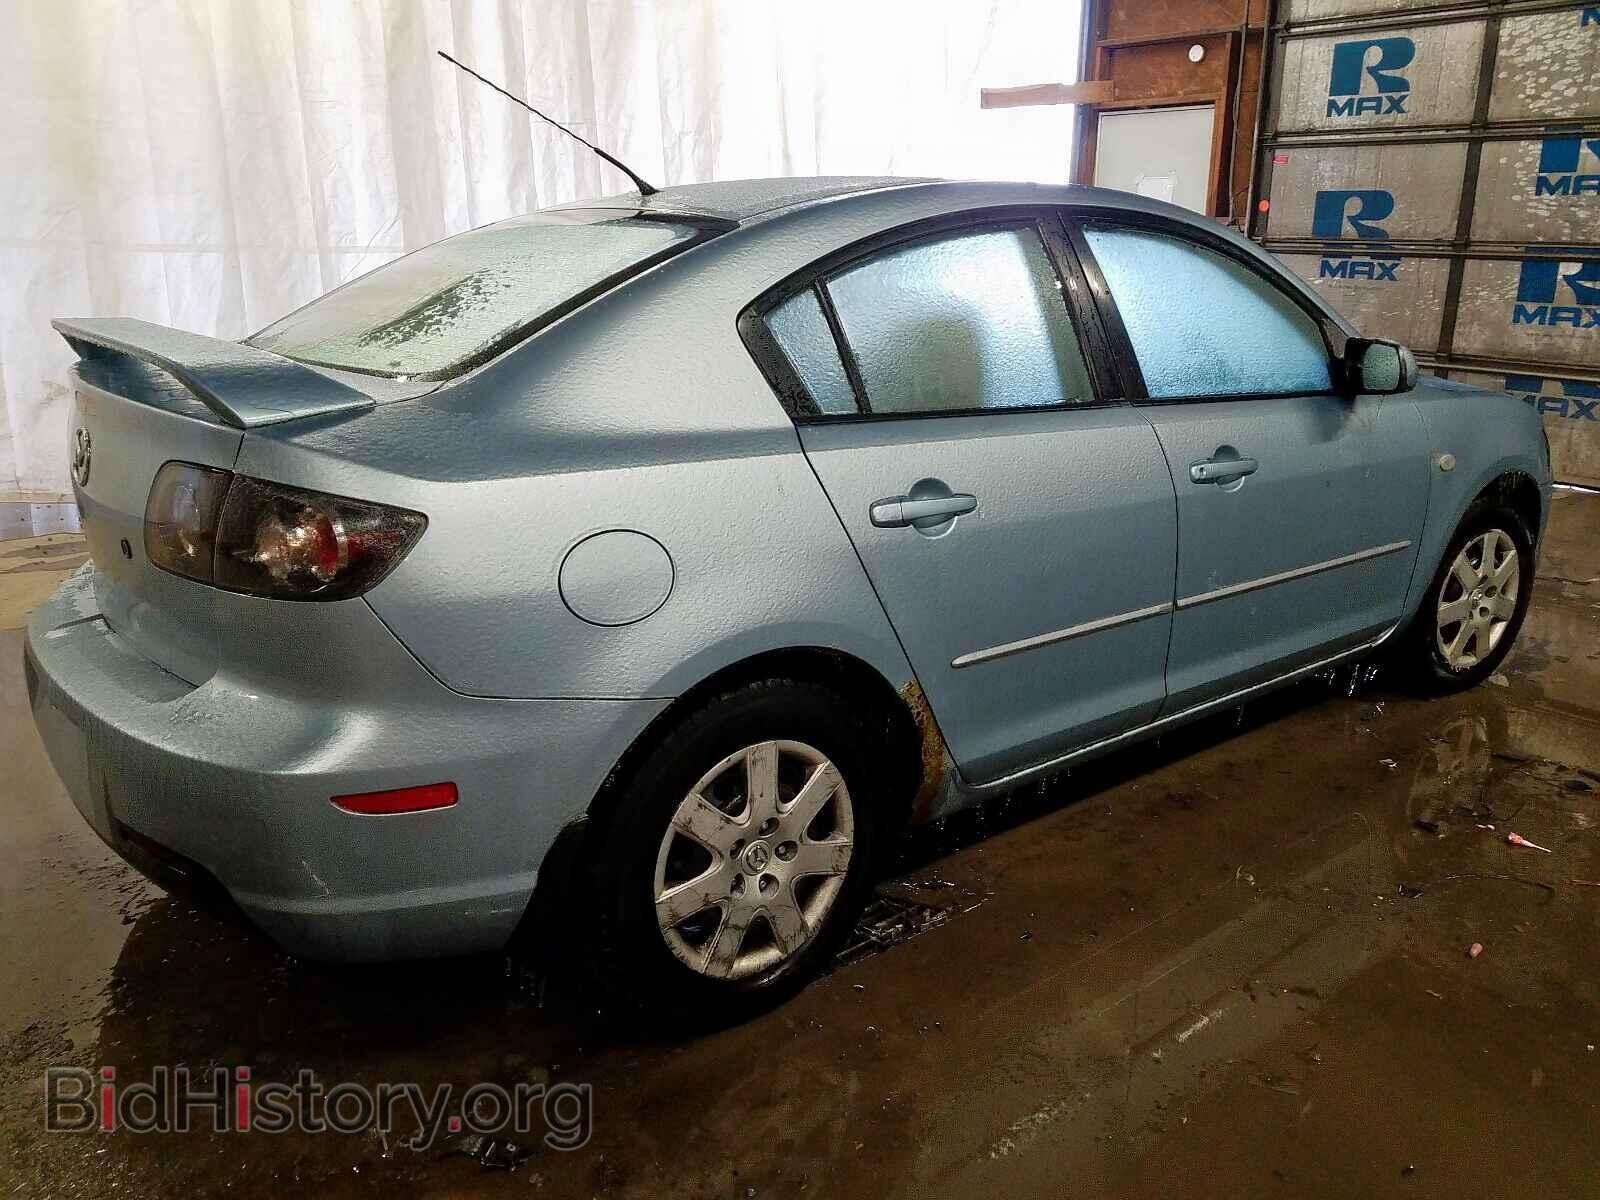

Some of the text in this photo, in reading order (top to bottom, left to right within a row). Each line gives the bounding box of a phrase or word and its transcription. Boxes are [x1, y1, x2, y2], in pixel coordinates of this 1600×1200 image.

[1329, 37, 1416, 96] R
[1327, 95, 1410, 118] MAX
[1536, 174, 1600, 197] MA
[1319, 259, 1401, 281] MAX
[1522, 394, 1599, 421] AX
